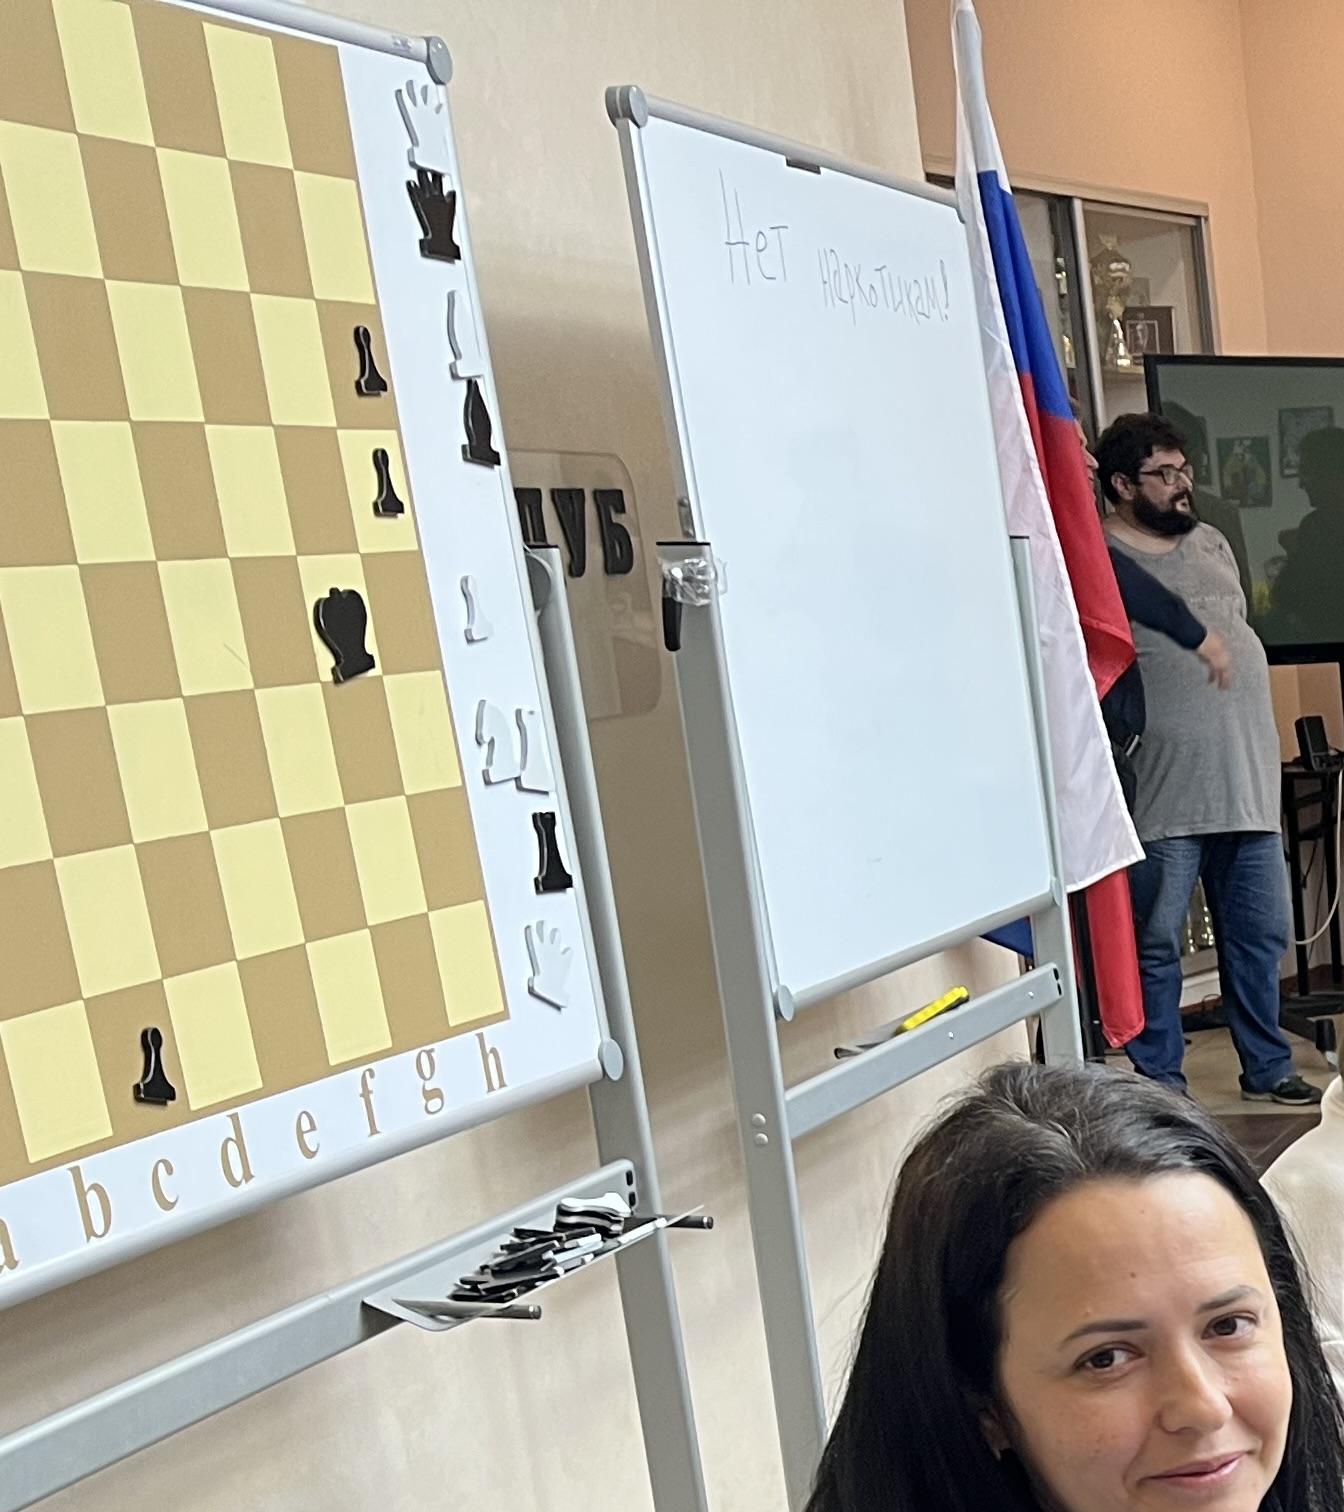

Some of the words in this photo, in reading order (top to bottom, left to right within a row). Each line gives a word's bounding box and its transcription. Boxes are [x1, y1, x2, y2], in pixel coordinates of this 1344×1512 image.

[718, 168, 789, 287] Нет
[66, 1166, 112, 1244] b
[151, 1157, 180, 1212] c
[220, 1113, 256, 1189] d
[295, 1109, 320, 1160] e
[358, 1068, 382, 1137] f
[415, 1046, 445, 1115] g
[474, 1032, 509, 1096] h
